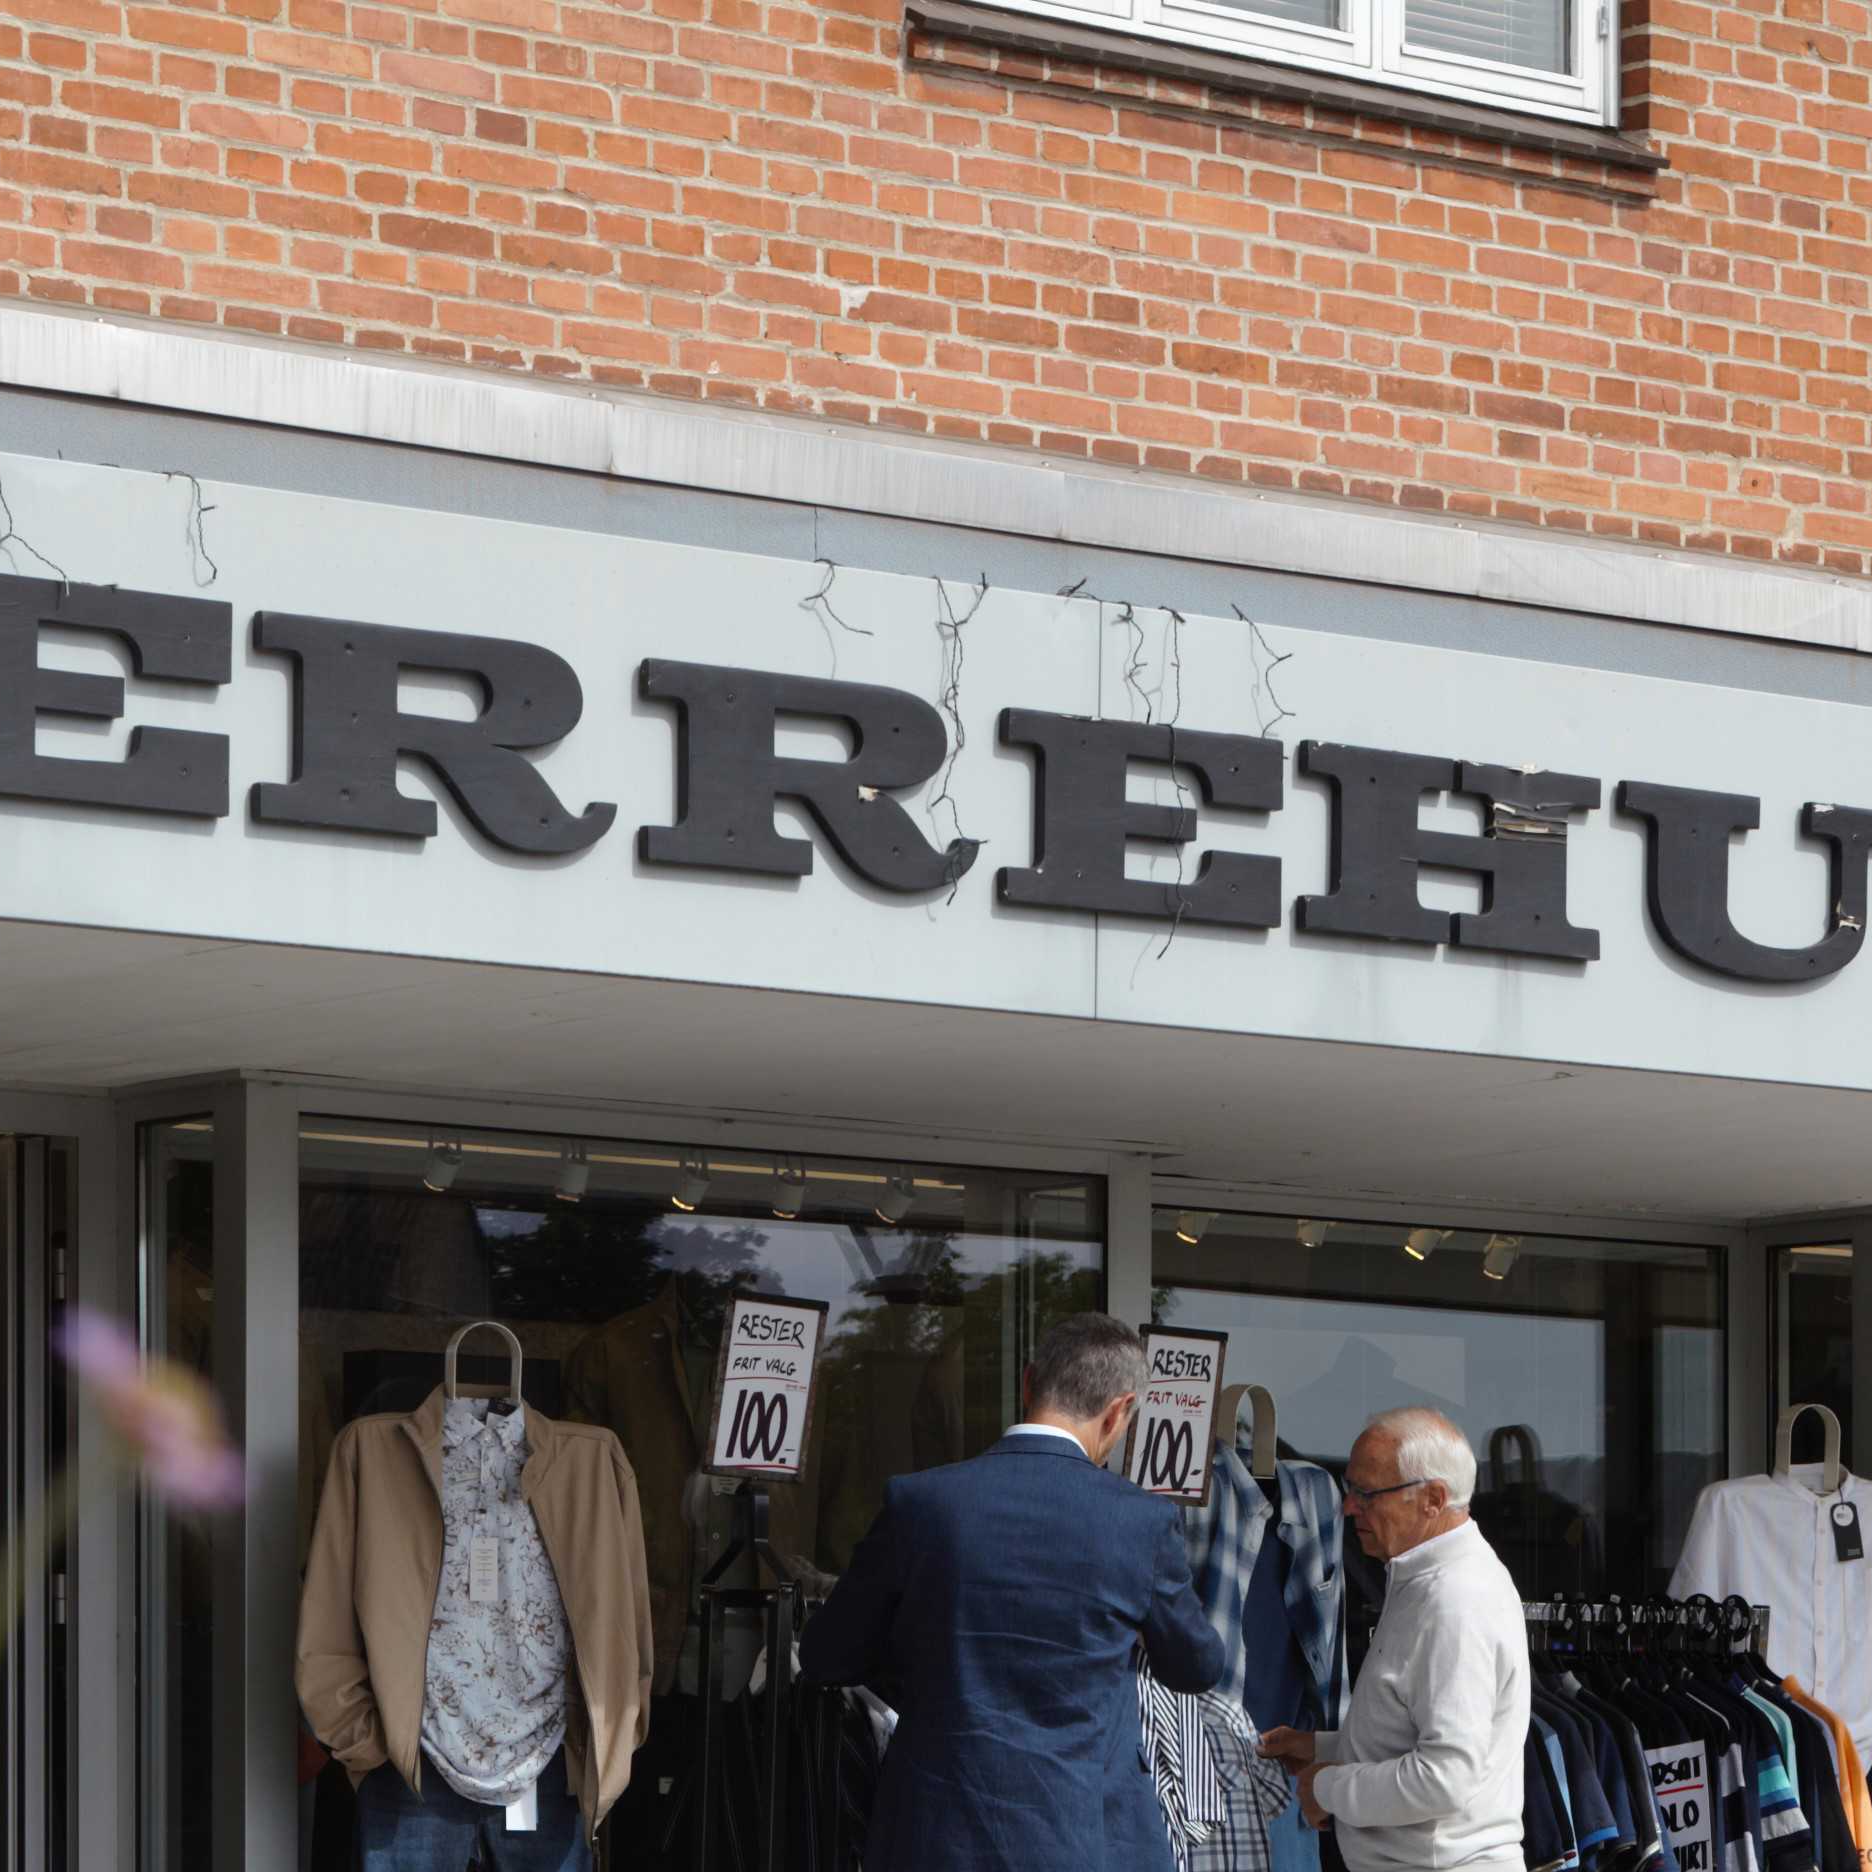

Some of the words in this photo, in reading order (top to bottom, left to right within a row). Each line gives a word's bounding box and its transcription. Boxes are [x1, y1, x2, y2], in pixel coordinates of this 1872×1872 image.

[738, 1314, 805, 1349] RESTER
[733, 1357, 761, 1371] FRIT
[766, 1359, 797, 1376] VALG
[1151, 1349, 1211, 1382] RESTER
[1145, 1391, 1173, 1407] FRIT
[1175, 1392, 1207, 1408] VALG
[1651, 1754, 1704, 1787] DSAT
